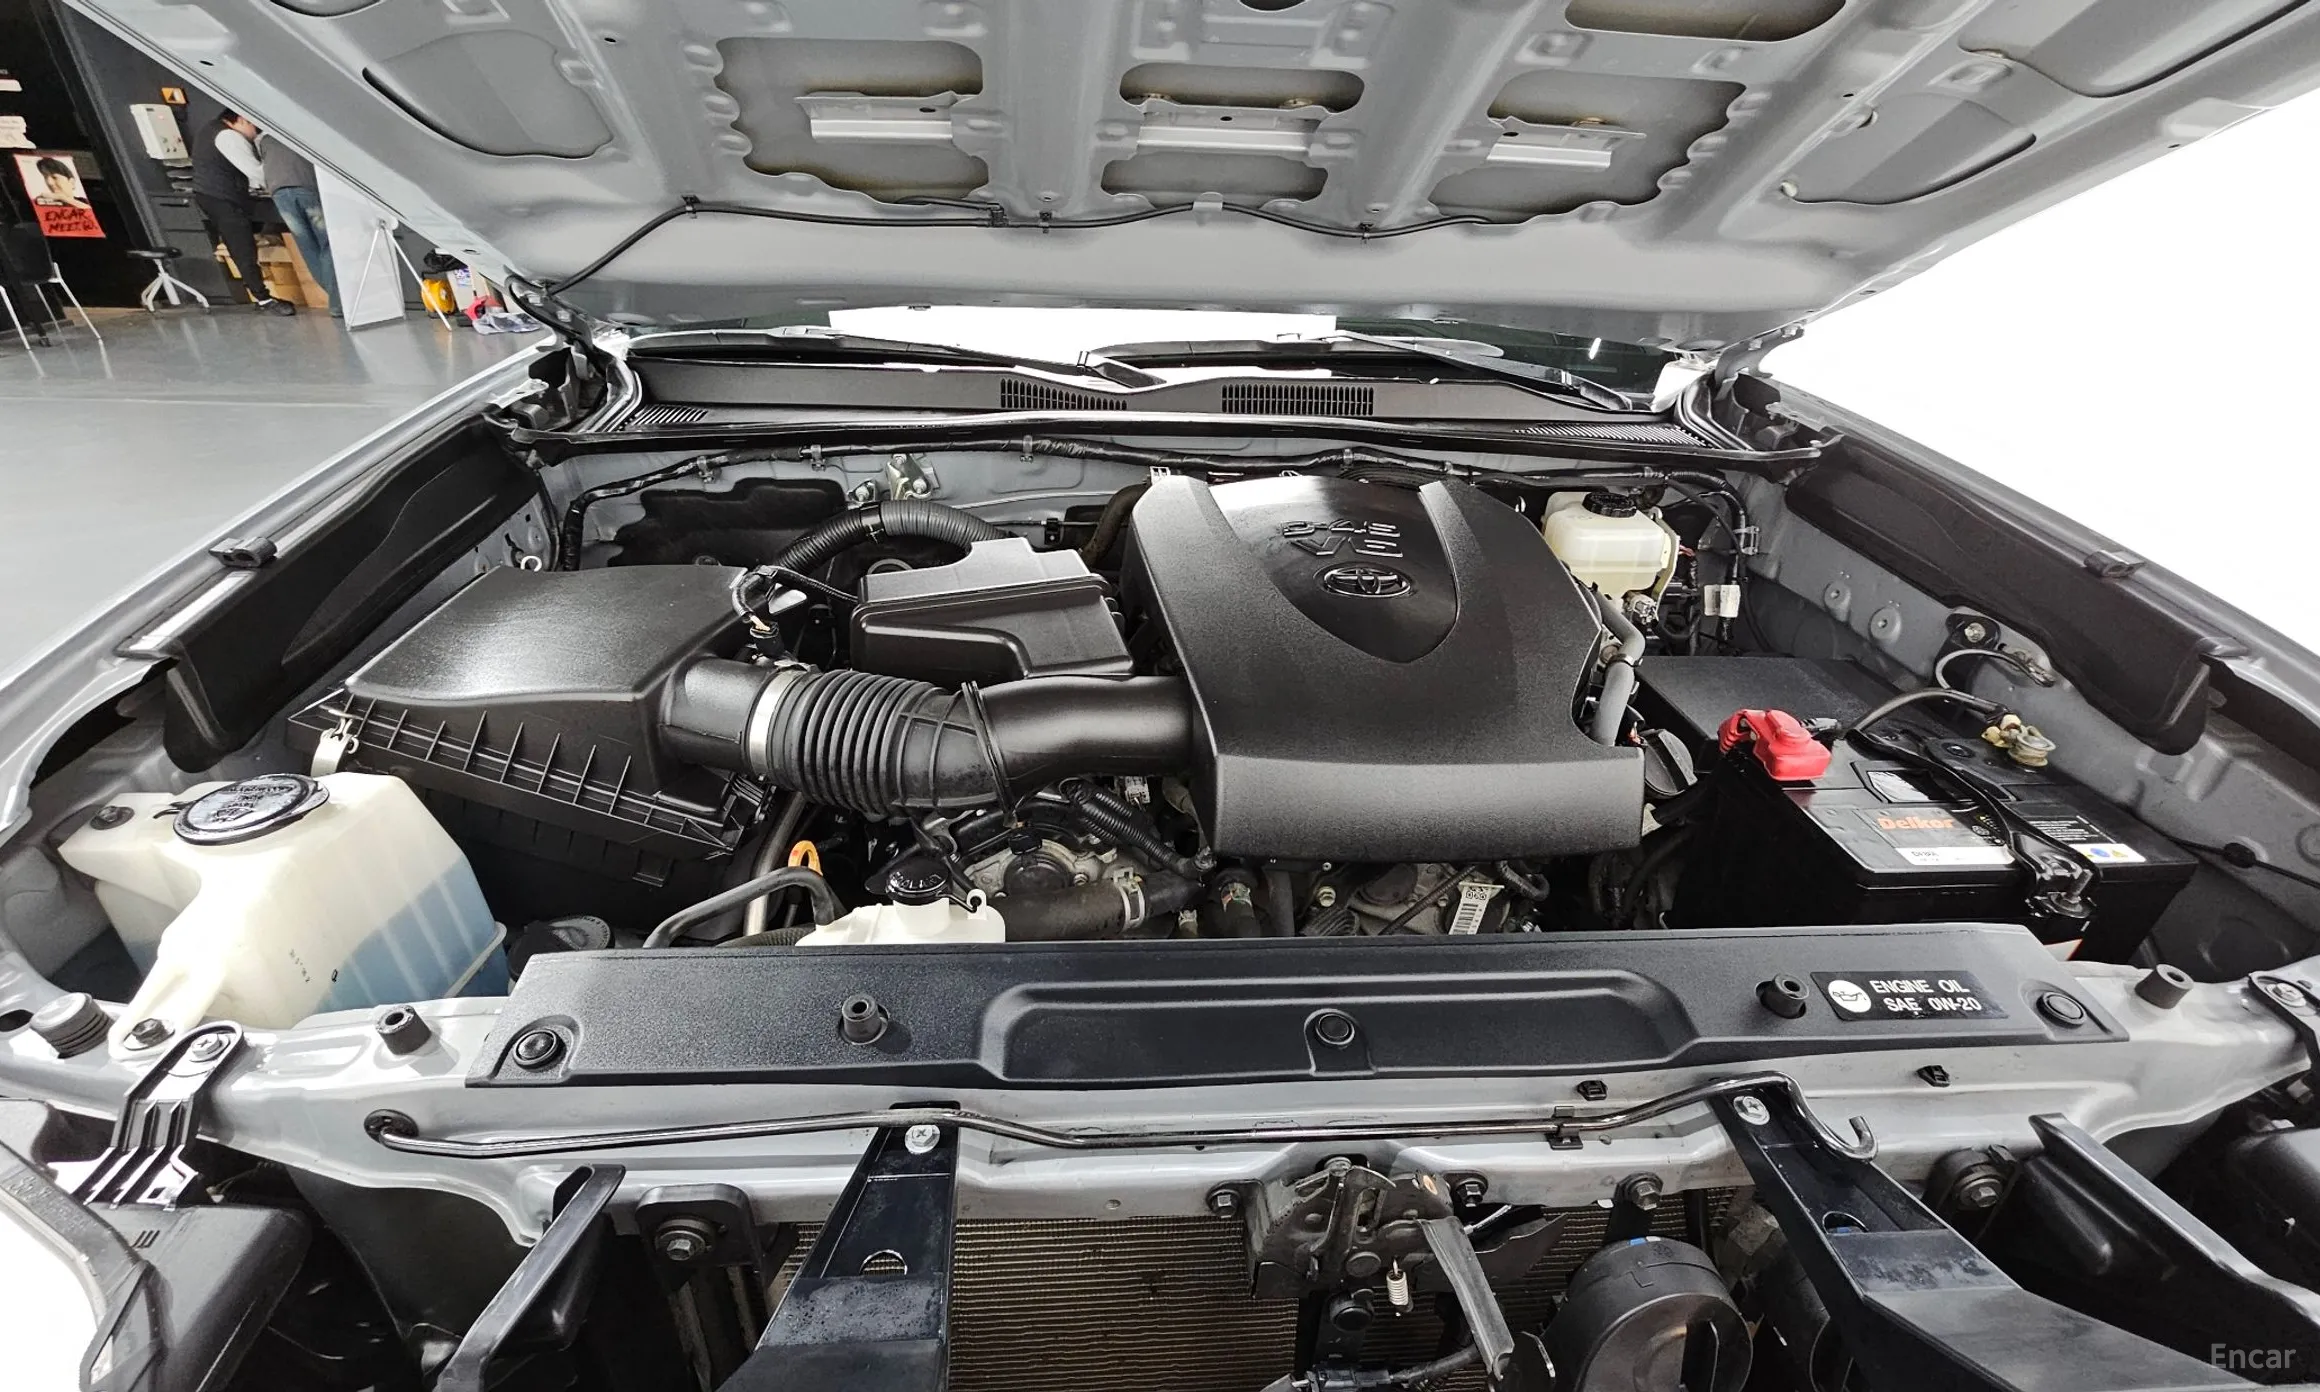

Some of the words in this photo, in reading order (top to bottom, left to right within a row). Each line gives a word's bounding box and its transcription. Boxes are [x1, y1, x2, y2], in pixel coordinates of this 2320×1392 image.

[1877, 816, 1954, 830] Delkor
[1868, 980, 1935, 994] ENGINE
[1938, 979, 1971, 993] OIL
[1883, 997, 1922, 1012] SAE
[1927, 997, 1983, 1011] 0W-20
